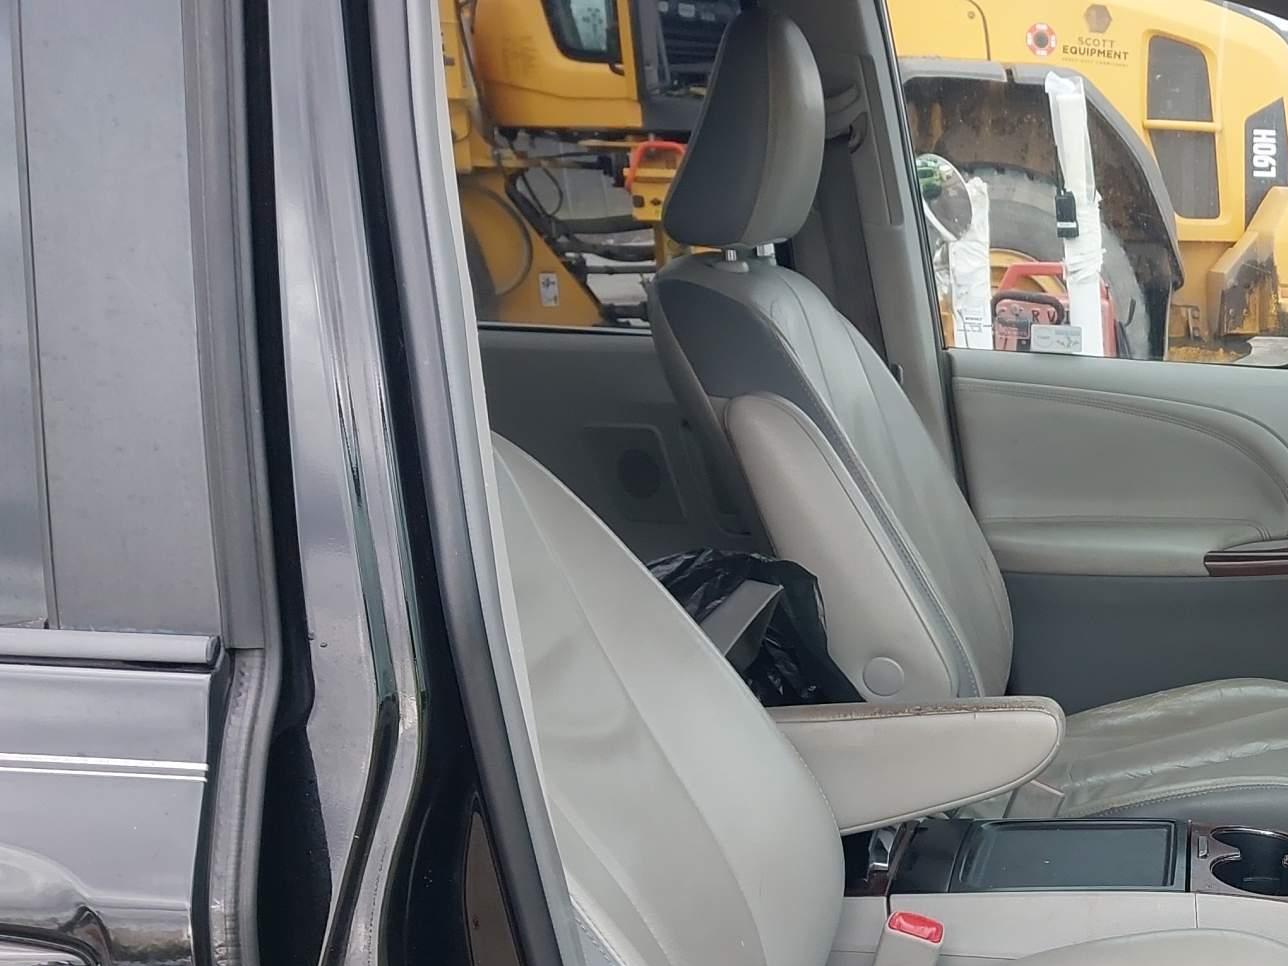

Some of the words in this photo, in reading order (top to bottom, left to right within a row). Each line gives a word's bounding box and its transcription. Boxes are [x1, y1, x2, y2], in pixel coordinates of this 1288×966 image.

[1077, 37, 1115, 48] SCOTT
[1062, 45, 1129, 60] EQUIPMENT
[1253, 129, 1277, 177] L90H
